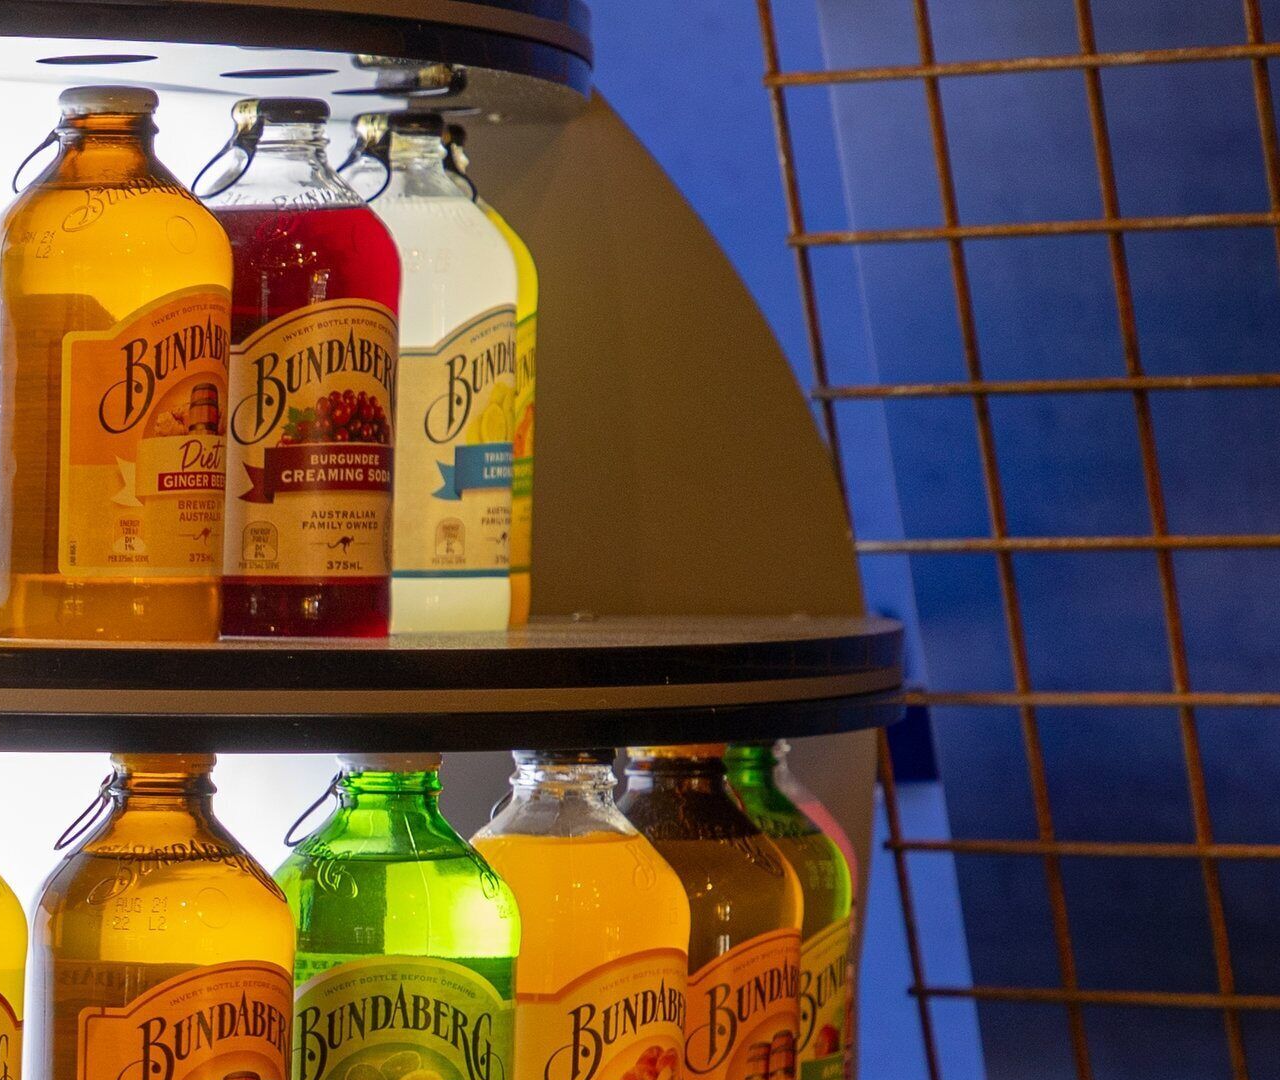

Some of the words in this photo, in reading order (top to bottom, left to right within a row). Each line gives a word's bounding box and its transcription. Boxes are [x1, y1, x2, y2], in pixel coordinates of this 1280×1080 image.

[311, 454, 379, 466] BURGUNDEE
[164, 472, 208, 488] GINGER
[282, 469, 364, 482] CREAMING
